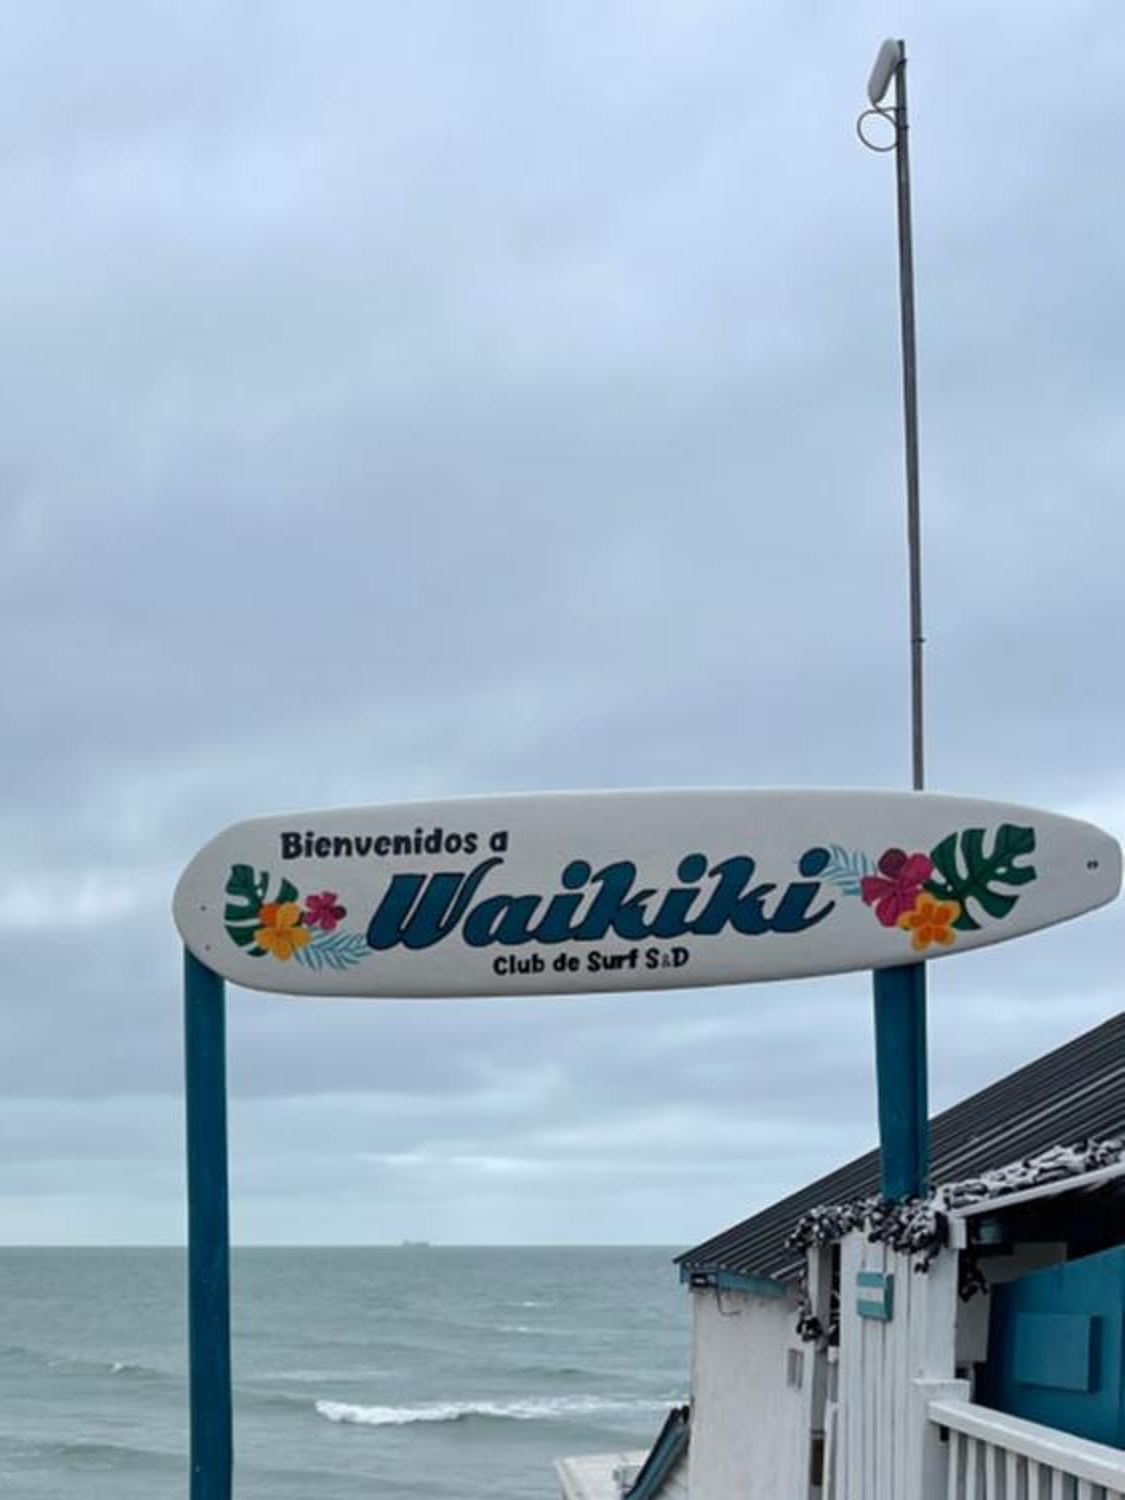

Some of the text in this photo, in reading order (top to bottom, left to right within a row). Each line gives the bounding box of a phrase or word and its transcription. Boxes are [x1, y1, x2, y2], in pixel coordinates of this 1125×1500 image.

[281, 827, 508, 860] Bienvenidos a
[366, 847, 835, 950] Waikiki
[493, 953, 545, 976] Club
[553, 953, 580, 972] de
[587, 948, 639, 972] Surf
